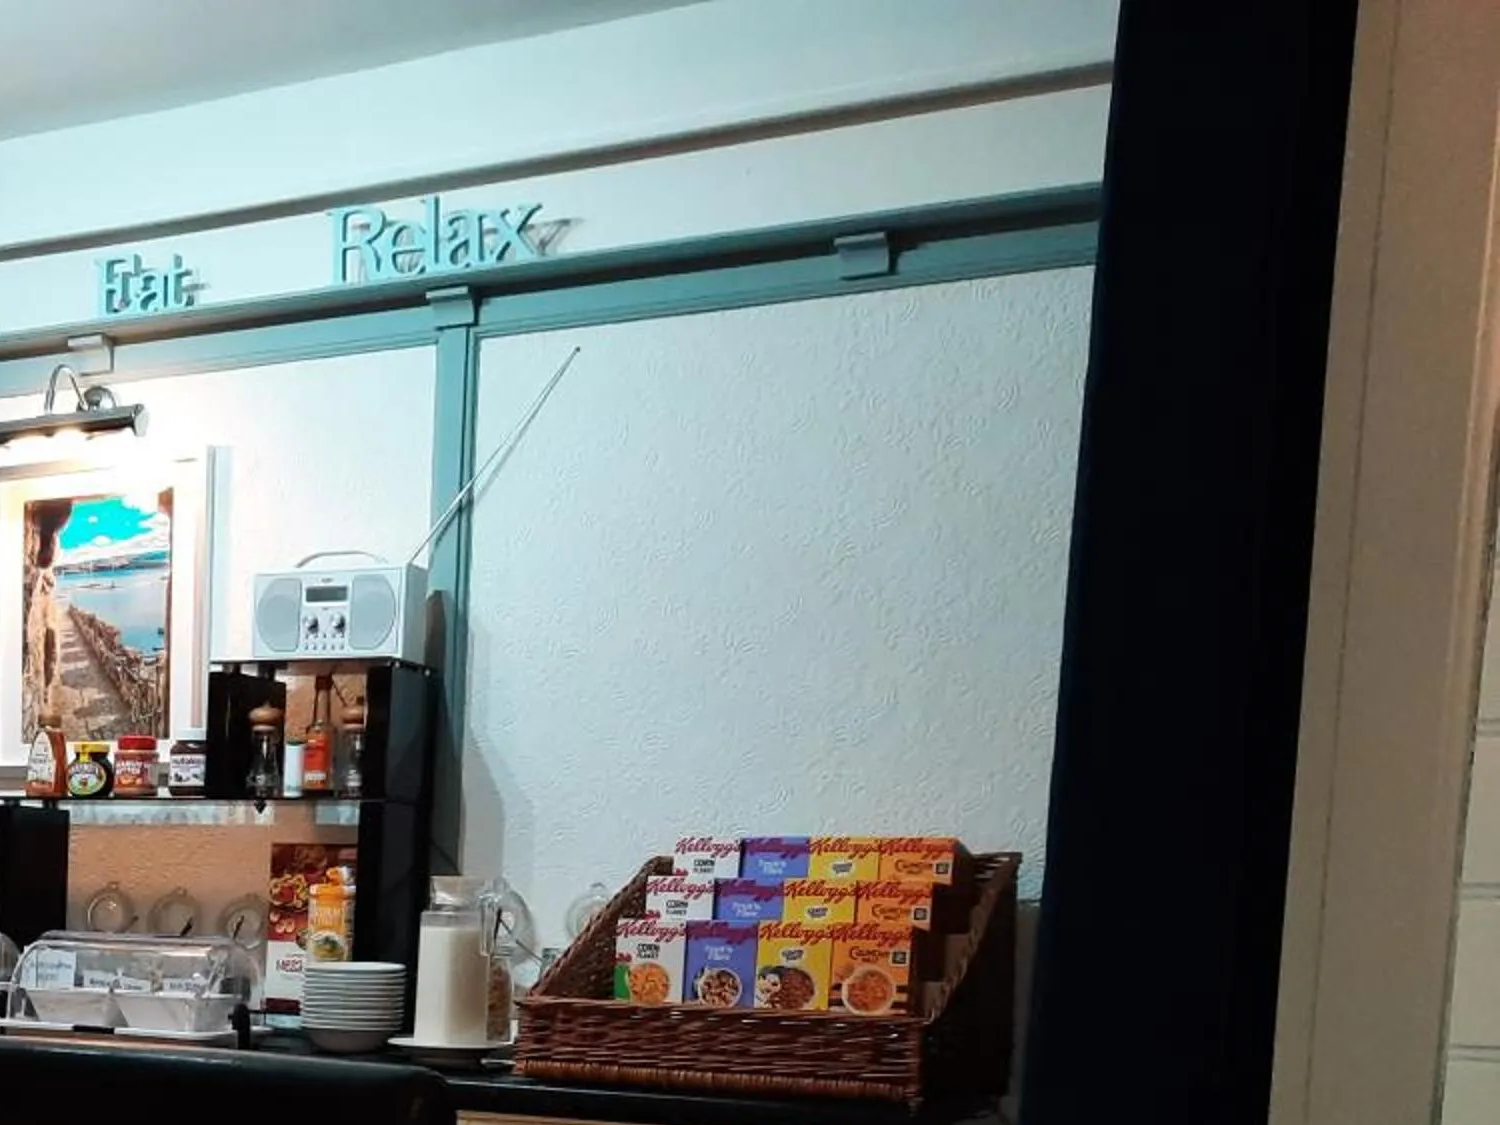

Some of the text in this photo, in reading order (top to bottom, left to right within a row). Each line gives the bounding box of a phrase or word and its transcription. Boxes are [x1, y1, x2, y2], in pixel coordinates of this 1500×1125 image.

[96, 252, 196, 320] Eat
[328, 194, 543, 288] Relax
[675, 836, 740, 859] Kellogg's
[646, 877, 714, 900] Kellogg's
[784, 879, 856, 903] Kellogg's
[614, 919, 686, 943] Kellogg's
[758, 921, 832, 946] Kellogg's
